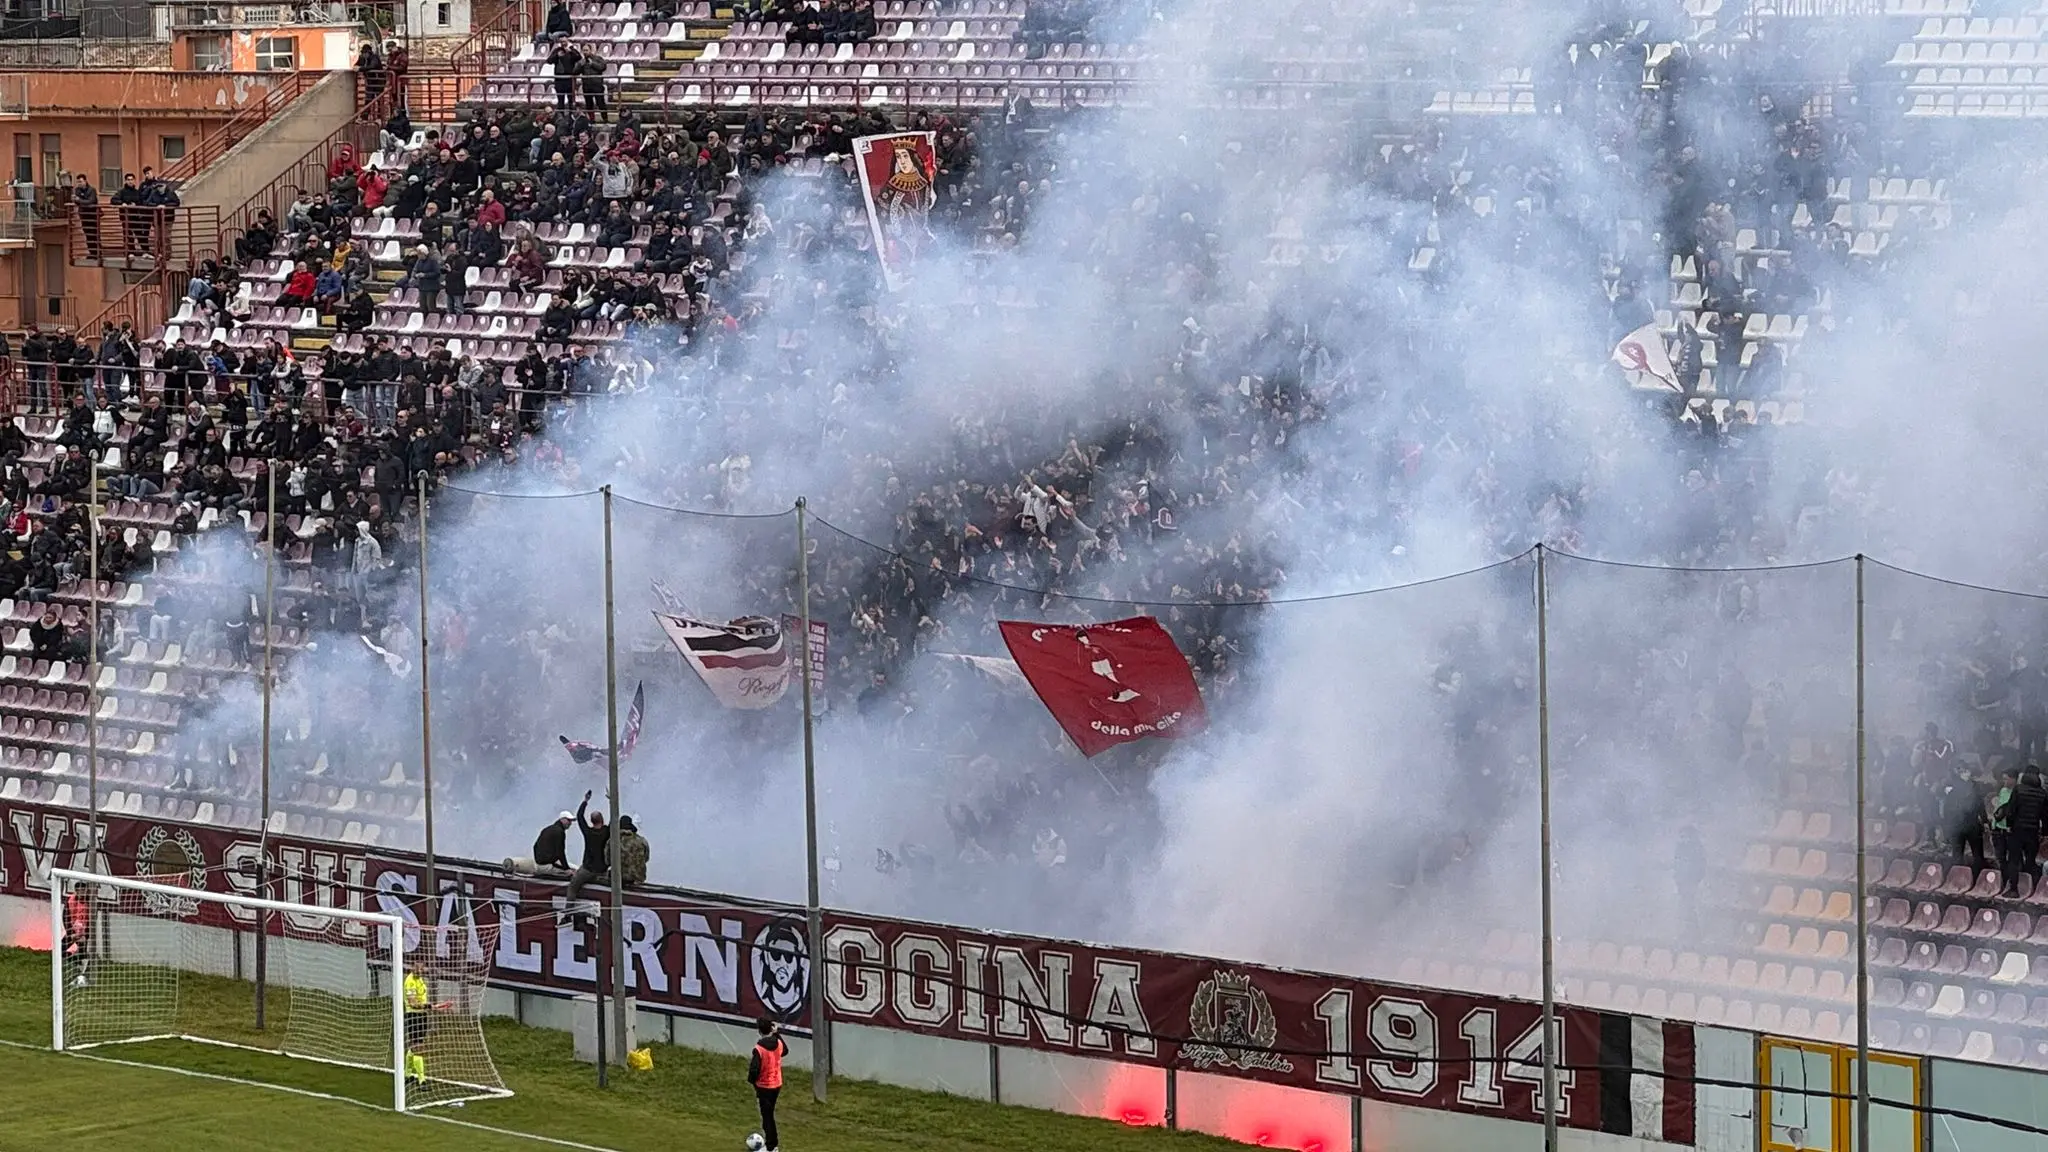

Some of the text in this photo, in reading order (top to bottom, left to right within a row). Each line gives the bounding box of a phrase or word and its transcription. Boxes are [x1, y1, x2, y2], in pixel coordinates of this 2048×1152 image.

[1090, 720, 1131, 737] della
[0, 808, 119, 905] VA
[1239, 1048, 1295, 1073] Calabria
[1313, 988, 1576, 1119] 1914
